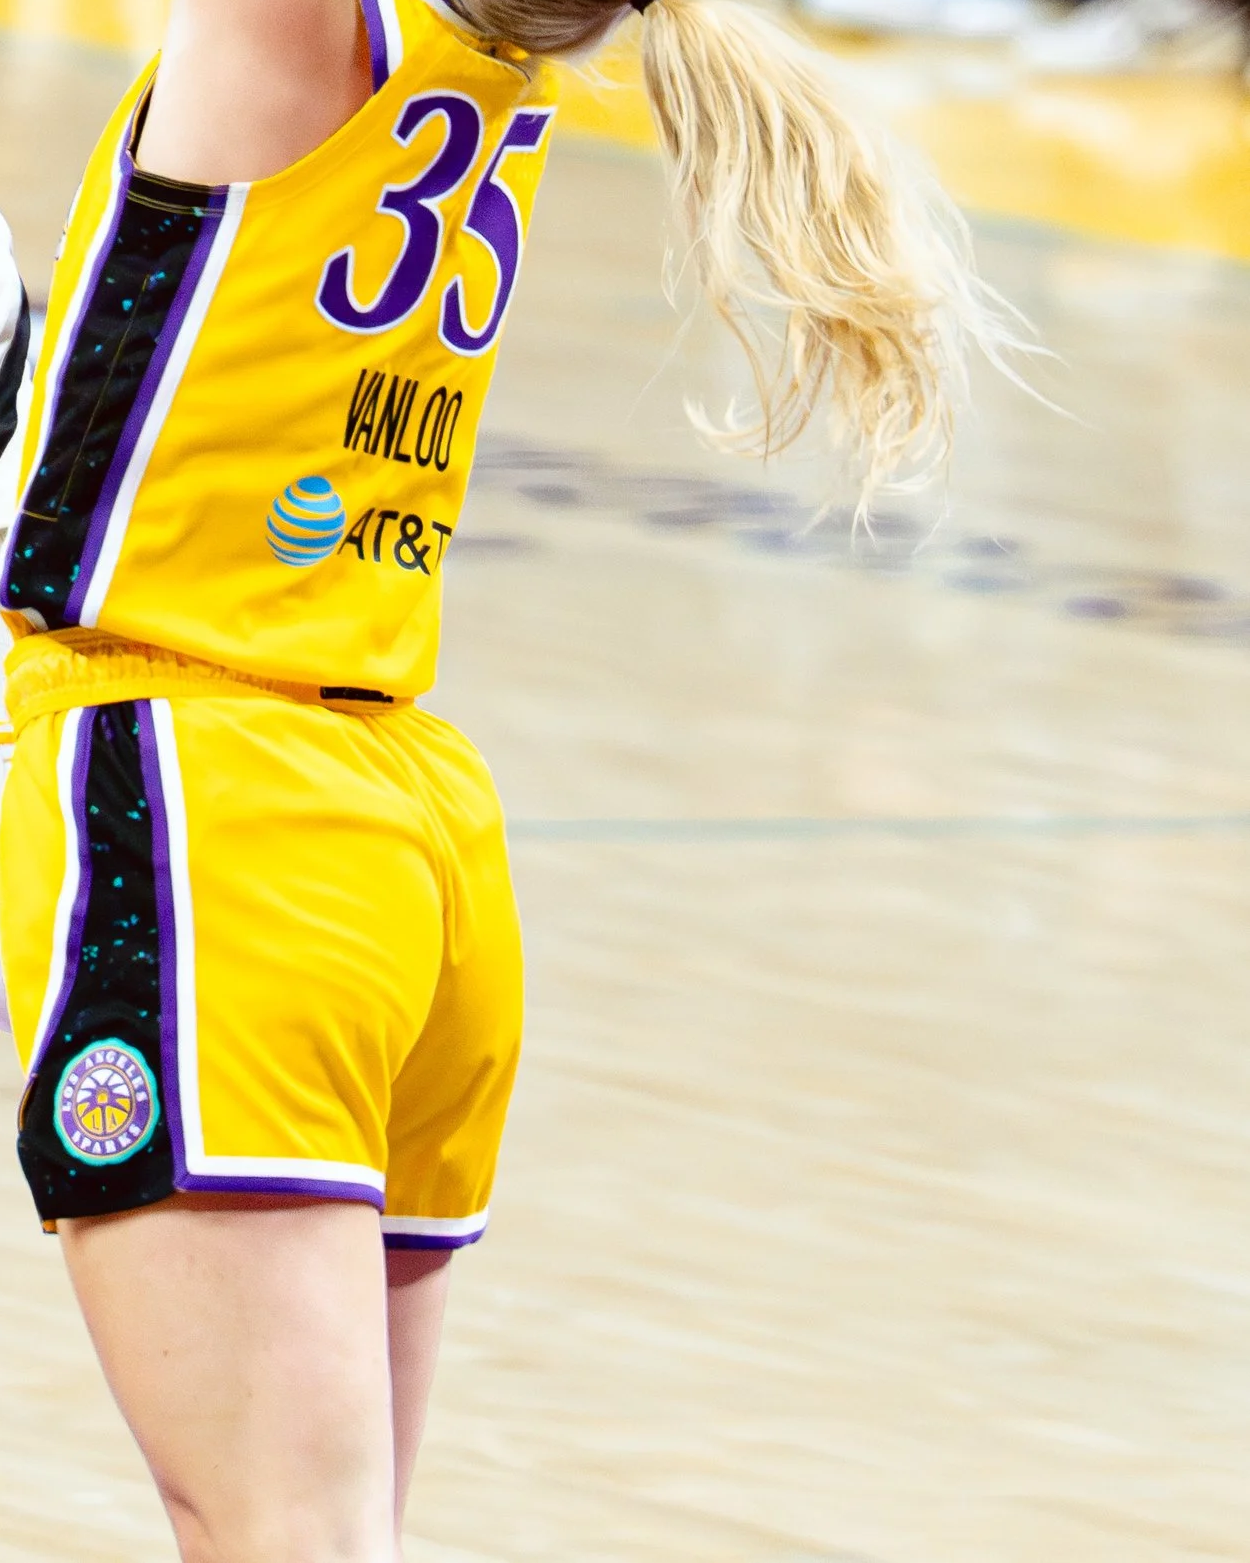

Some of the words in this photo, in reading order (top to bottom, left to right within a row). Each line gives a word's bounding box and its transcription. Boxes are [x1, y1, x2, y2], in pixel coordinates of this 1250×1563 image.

[313, 88, 557, 358] 35
[343, 368, 463, 473] VANLOO
[337, 507, 453, 576] AT&T
[62, 1073, 80, 1112] LOS
[84, 1050, 148, 1103] ANGELES
[72, 1123, 142, 1154] SPARKS
